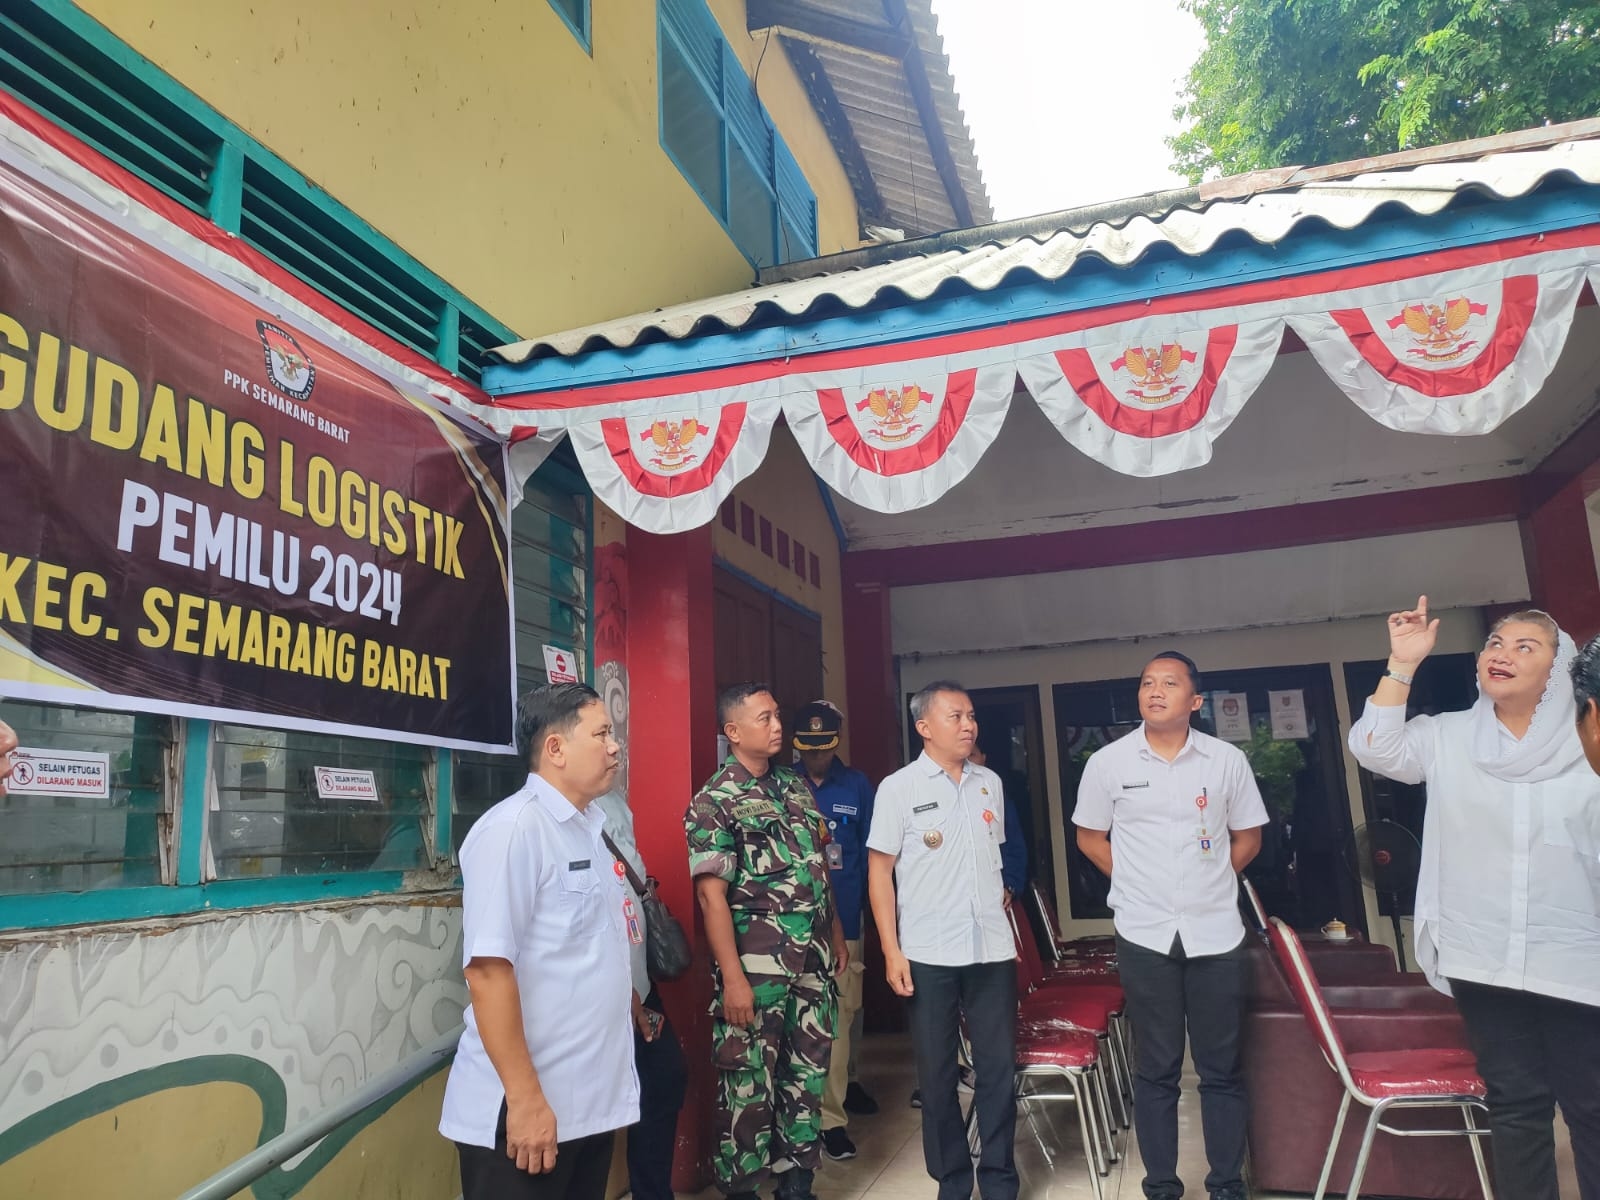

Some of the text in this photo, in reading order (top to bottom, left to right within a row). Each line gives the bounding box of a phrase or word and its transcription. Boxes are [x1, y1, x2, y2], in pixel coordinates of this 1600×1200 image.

[0, 312, 465, 579] GUDANG LOGISTIK
[224, 369, 350, 444] PPK SEMARANG BARAT
[116, 478, 402, 626] PEMILU 2024
[0, 552, 451, 700] KEC. SEMARANG BARAT
[36, 776, 102, 787] DILARANG MASUK
[38, 763, 101, 775] SELAIN PETUGAS
